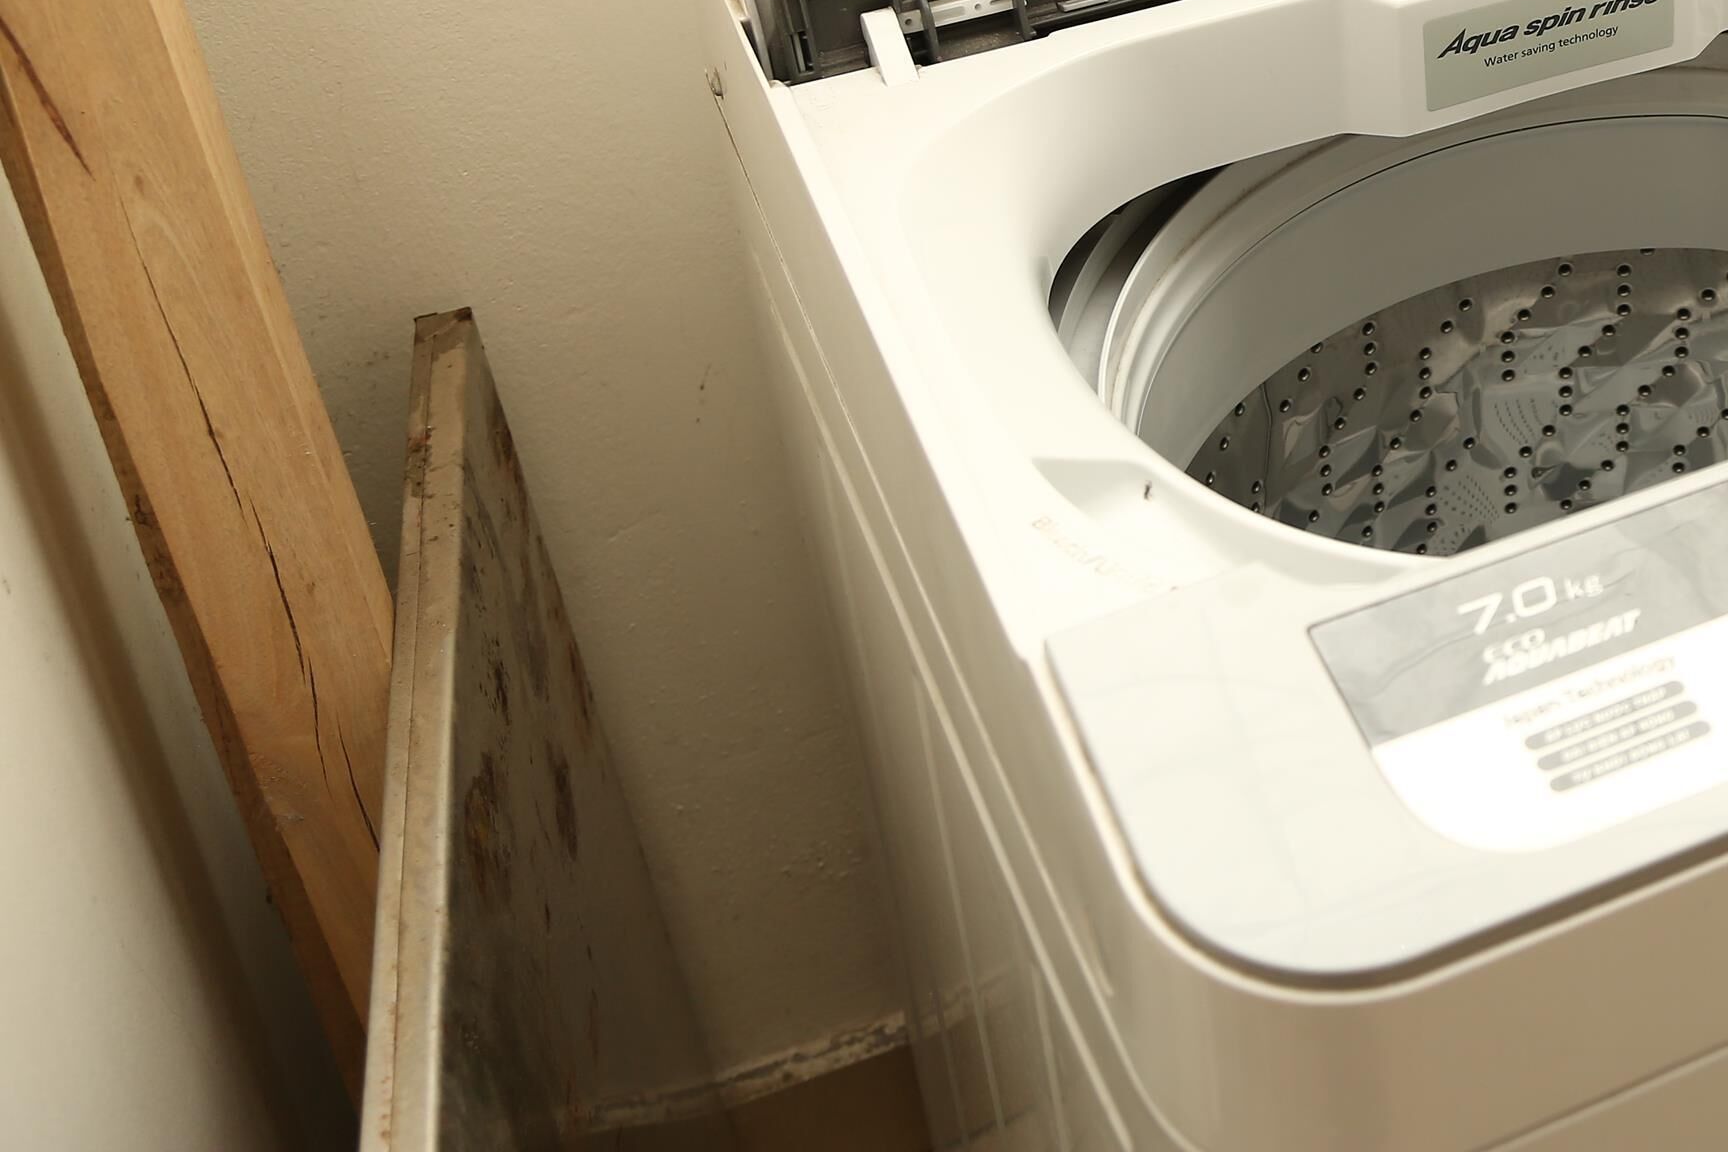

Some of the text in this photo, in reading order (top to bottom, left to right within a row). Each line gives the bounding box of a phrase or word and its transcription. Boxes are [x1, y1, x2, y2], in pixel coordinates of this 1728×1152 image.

[1437, 24, 1520, 59] Aqua
[1523, 6, 1587, 37] spin
[1484, 24, 1619, 68] Water saving technology
[1457, 574, 1604, 635] 7.0 kg
